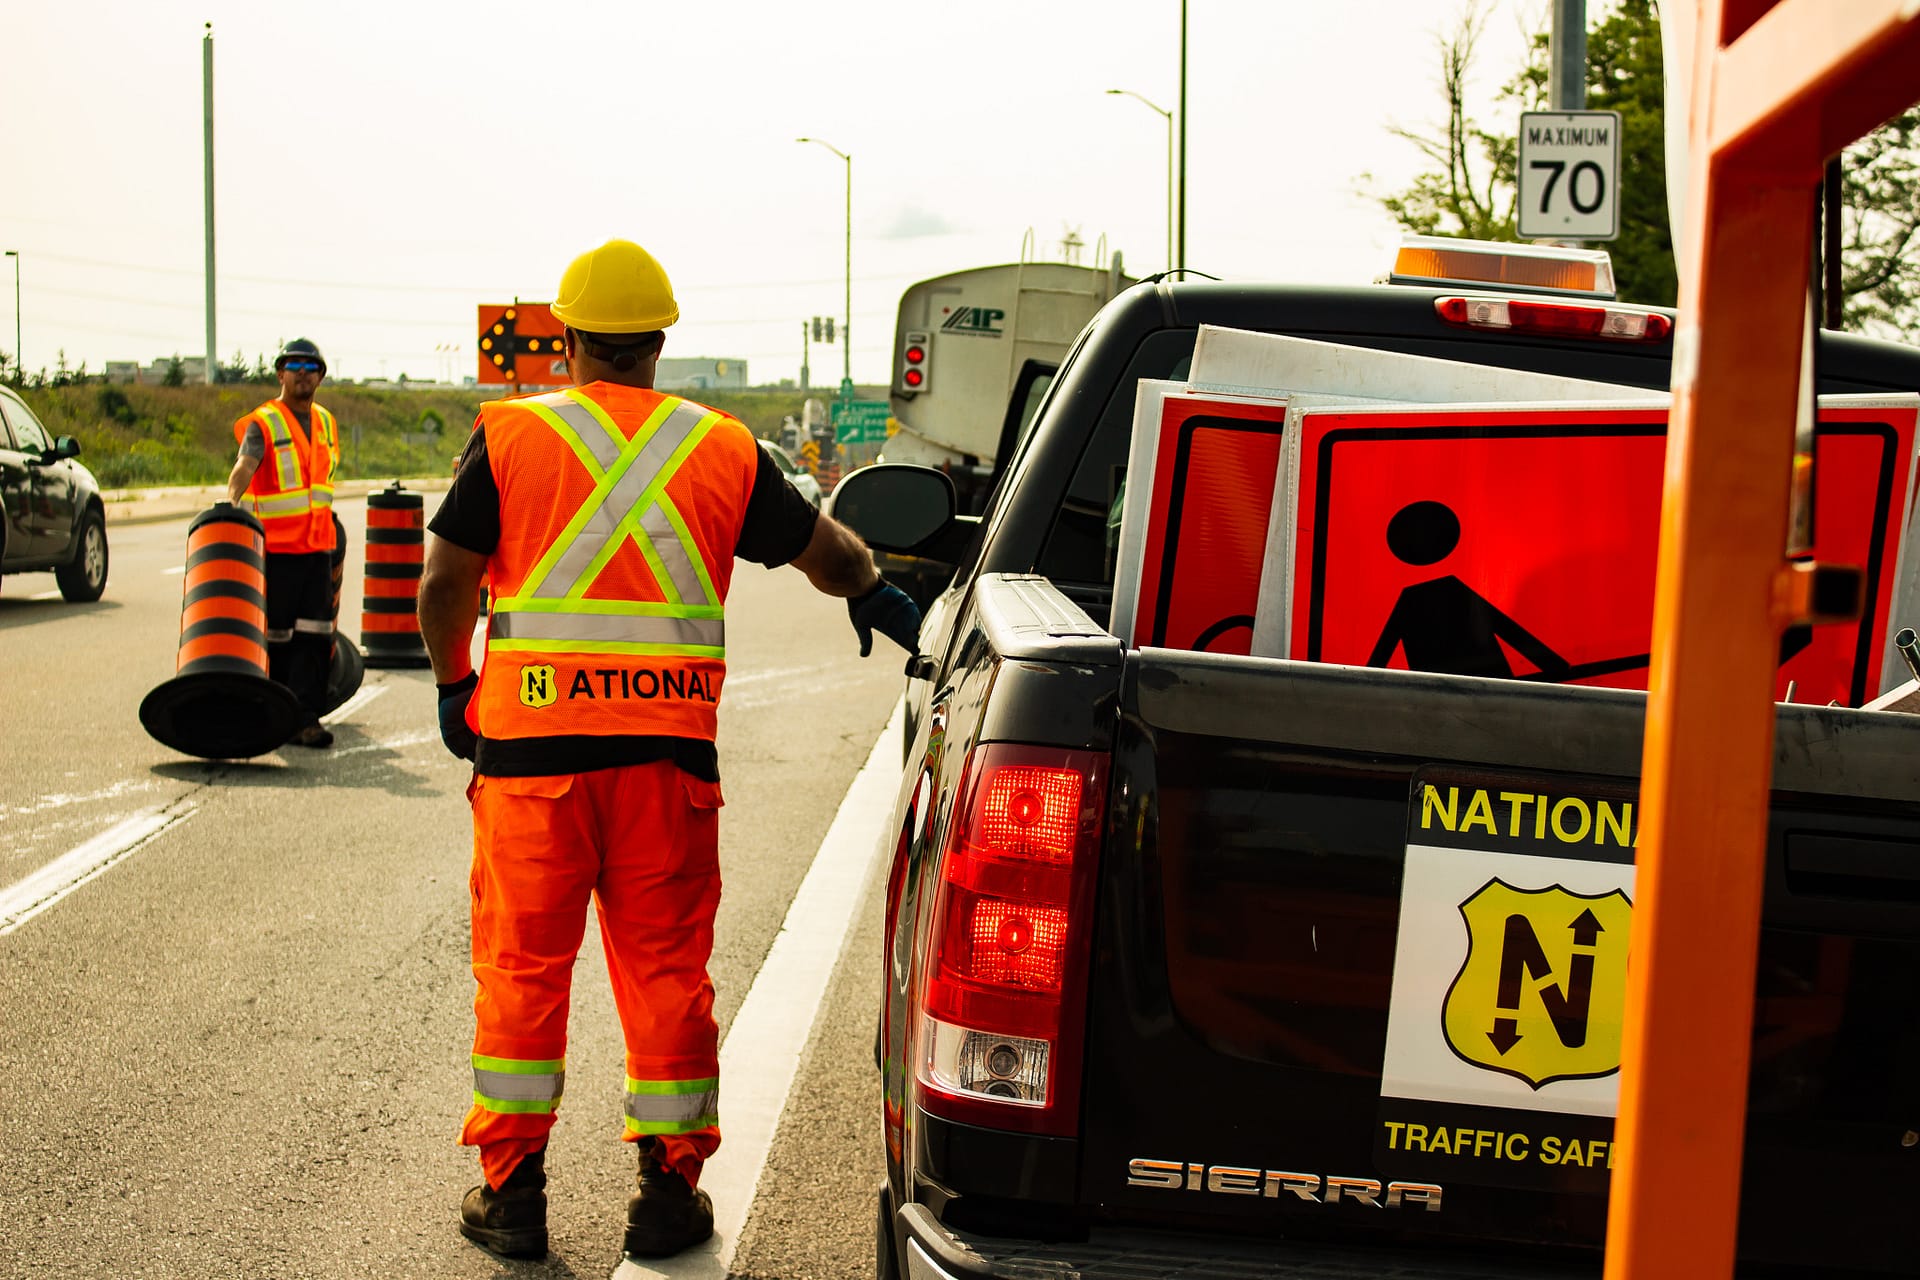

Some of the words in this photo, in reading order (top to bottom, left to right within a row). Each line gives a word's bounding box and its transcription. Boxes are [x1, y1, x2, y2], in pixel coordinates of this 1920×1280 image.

[1528, 127, 1608, 146] MAXIMUM
[1530, 160, 1605, 215] 70
[1420, 784, 1641, 848] NATION
[1384, 1121, 1530, 1162] TRAFFIC
[1127, 1158, 1443, 1212] SIERRA
